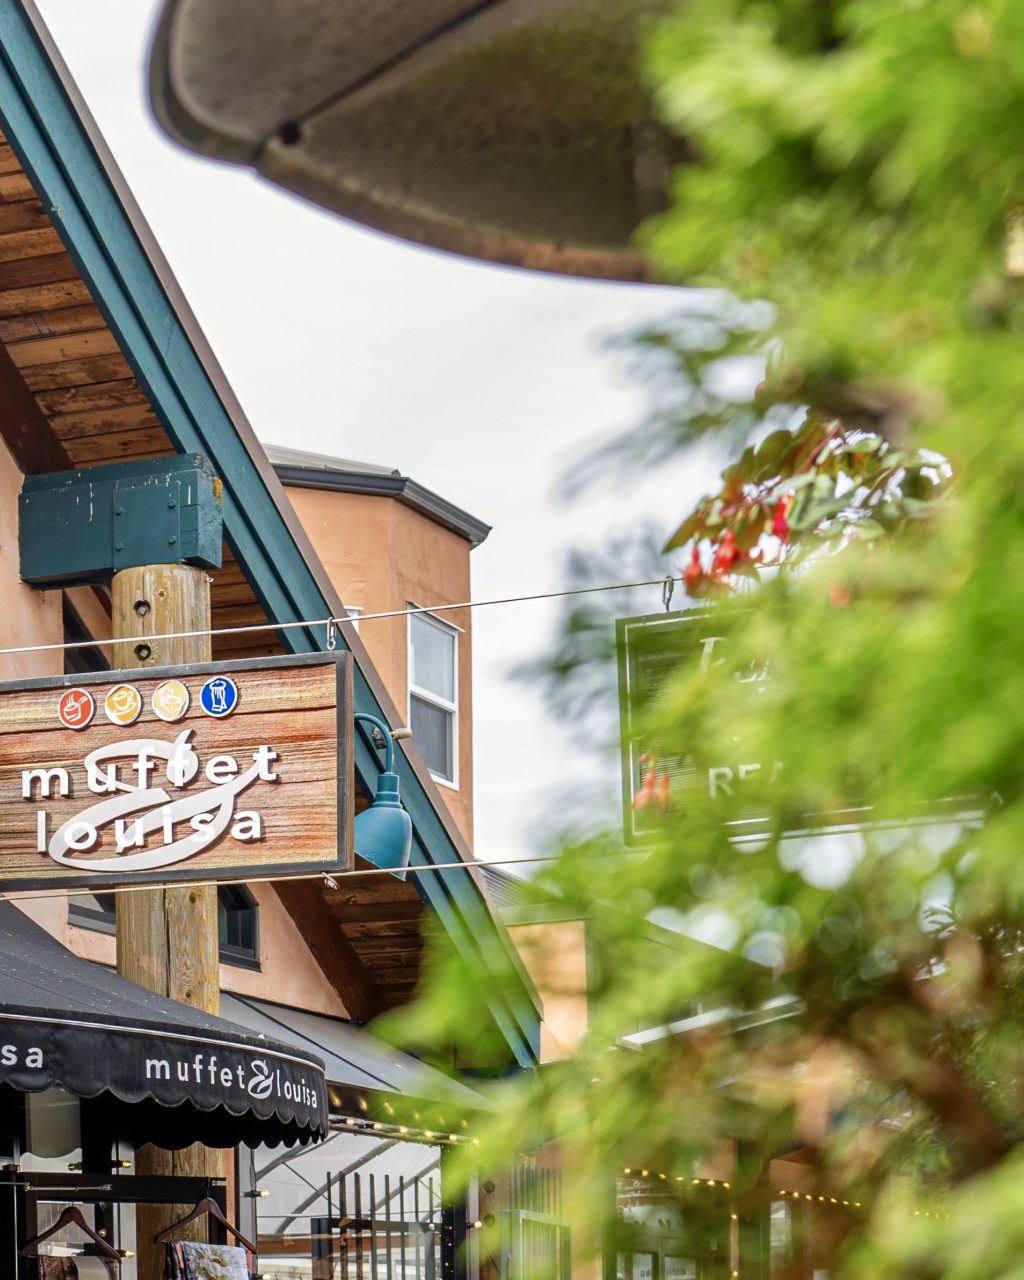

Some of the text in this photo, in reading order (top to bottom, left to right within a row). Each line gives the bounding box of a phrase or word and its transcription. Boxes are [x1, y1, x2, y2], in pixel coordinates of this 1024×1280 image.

[21, 743, 278, 799] muffet
[36, 806, 262, 853] louisa
[145, 1054, 245, 1089] muffet
[276, 1069, 318, 1108] louisa
